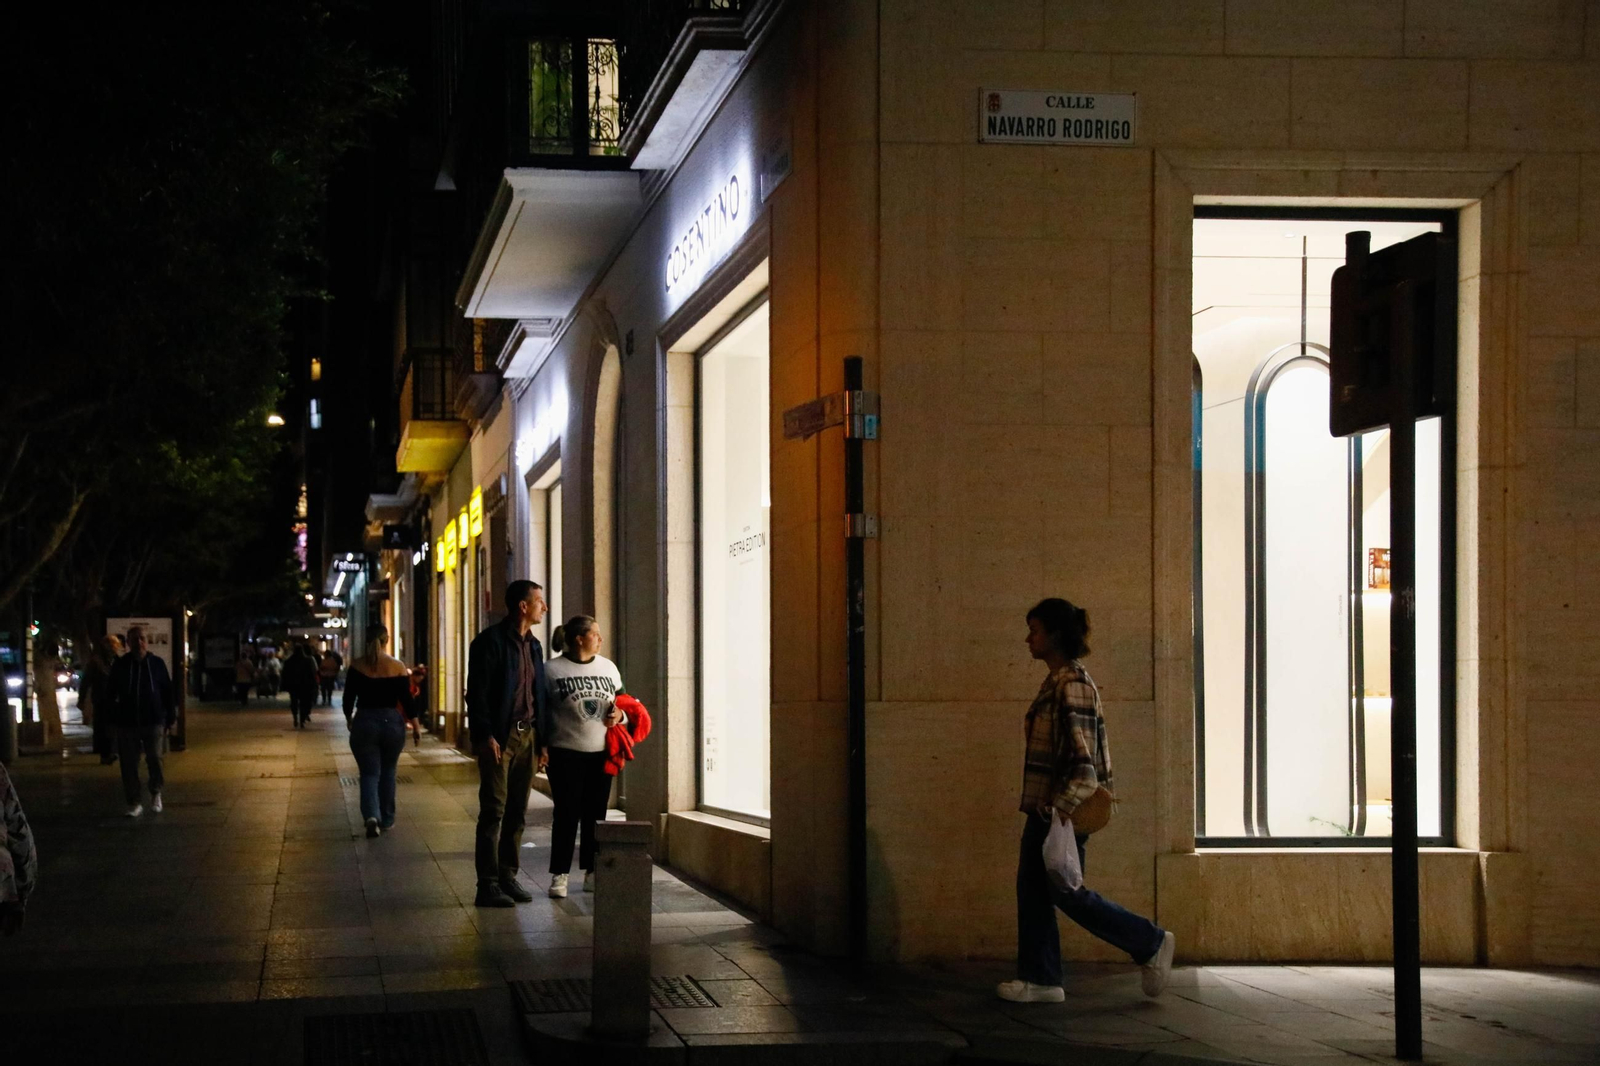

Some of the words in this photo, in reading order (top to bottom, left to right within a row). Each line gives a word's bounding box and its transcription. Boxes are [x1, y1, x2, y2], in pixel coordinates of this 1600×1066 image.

[1045, 95, 1095, 109] CALLE
[988, 115, 1057, 137] NAVARRO
[1063, 118, 1131, 140] RODRIGO
[665, 174, 740, 294] COSENTINO
[323, 617, 349, 629] JOY
[556, 675, 616, 697] HOUSTON
[571, 691, 592, 702] SPACE
[594, 691, 609, 701] CITY
